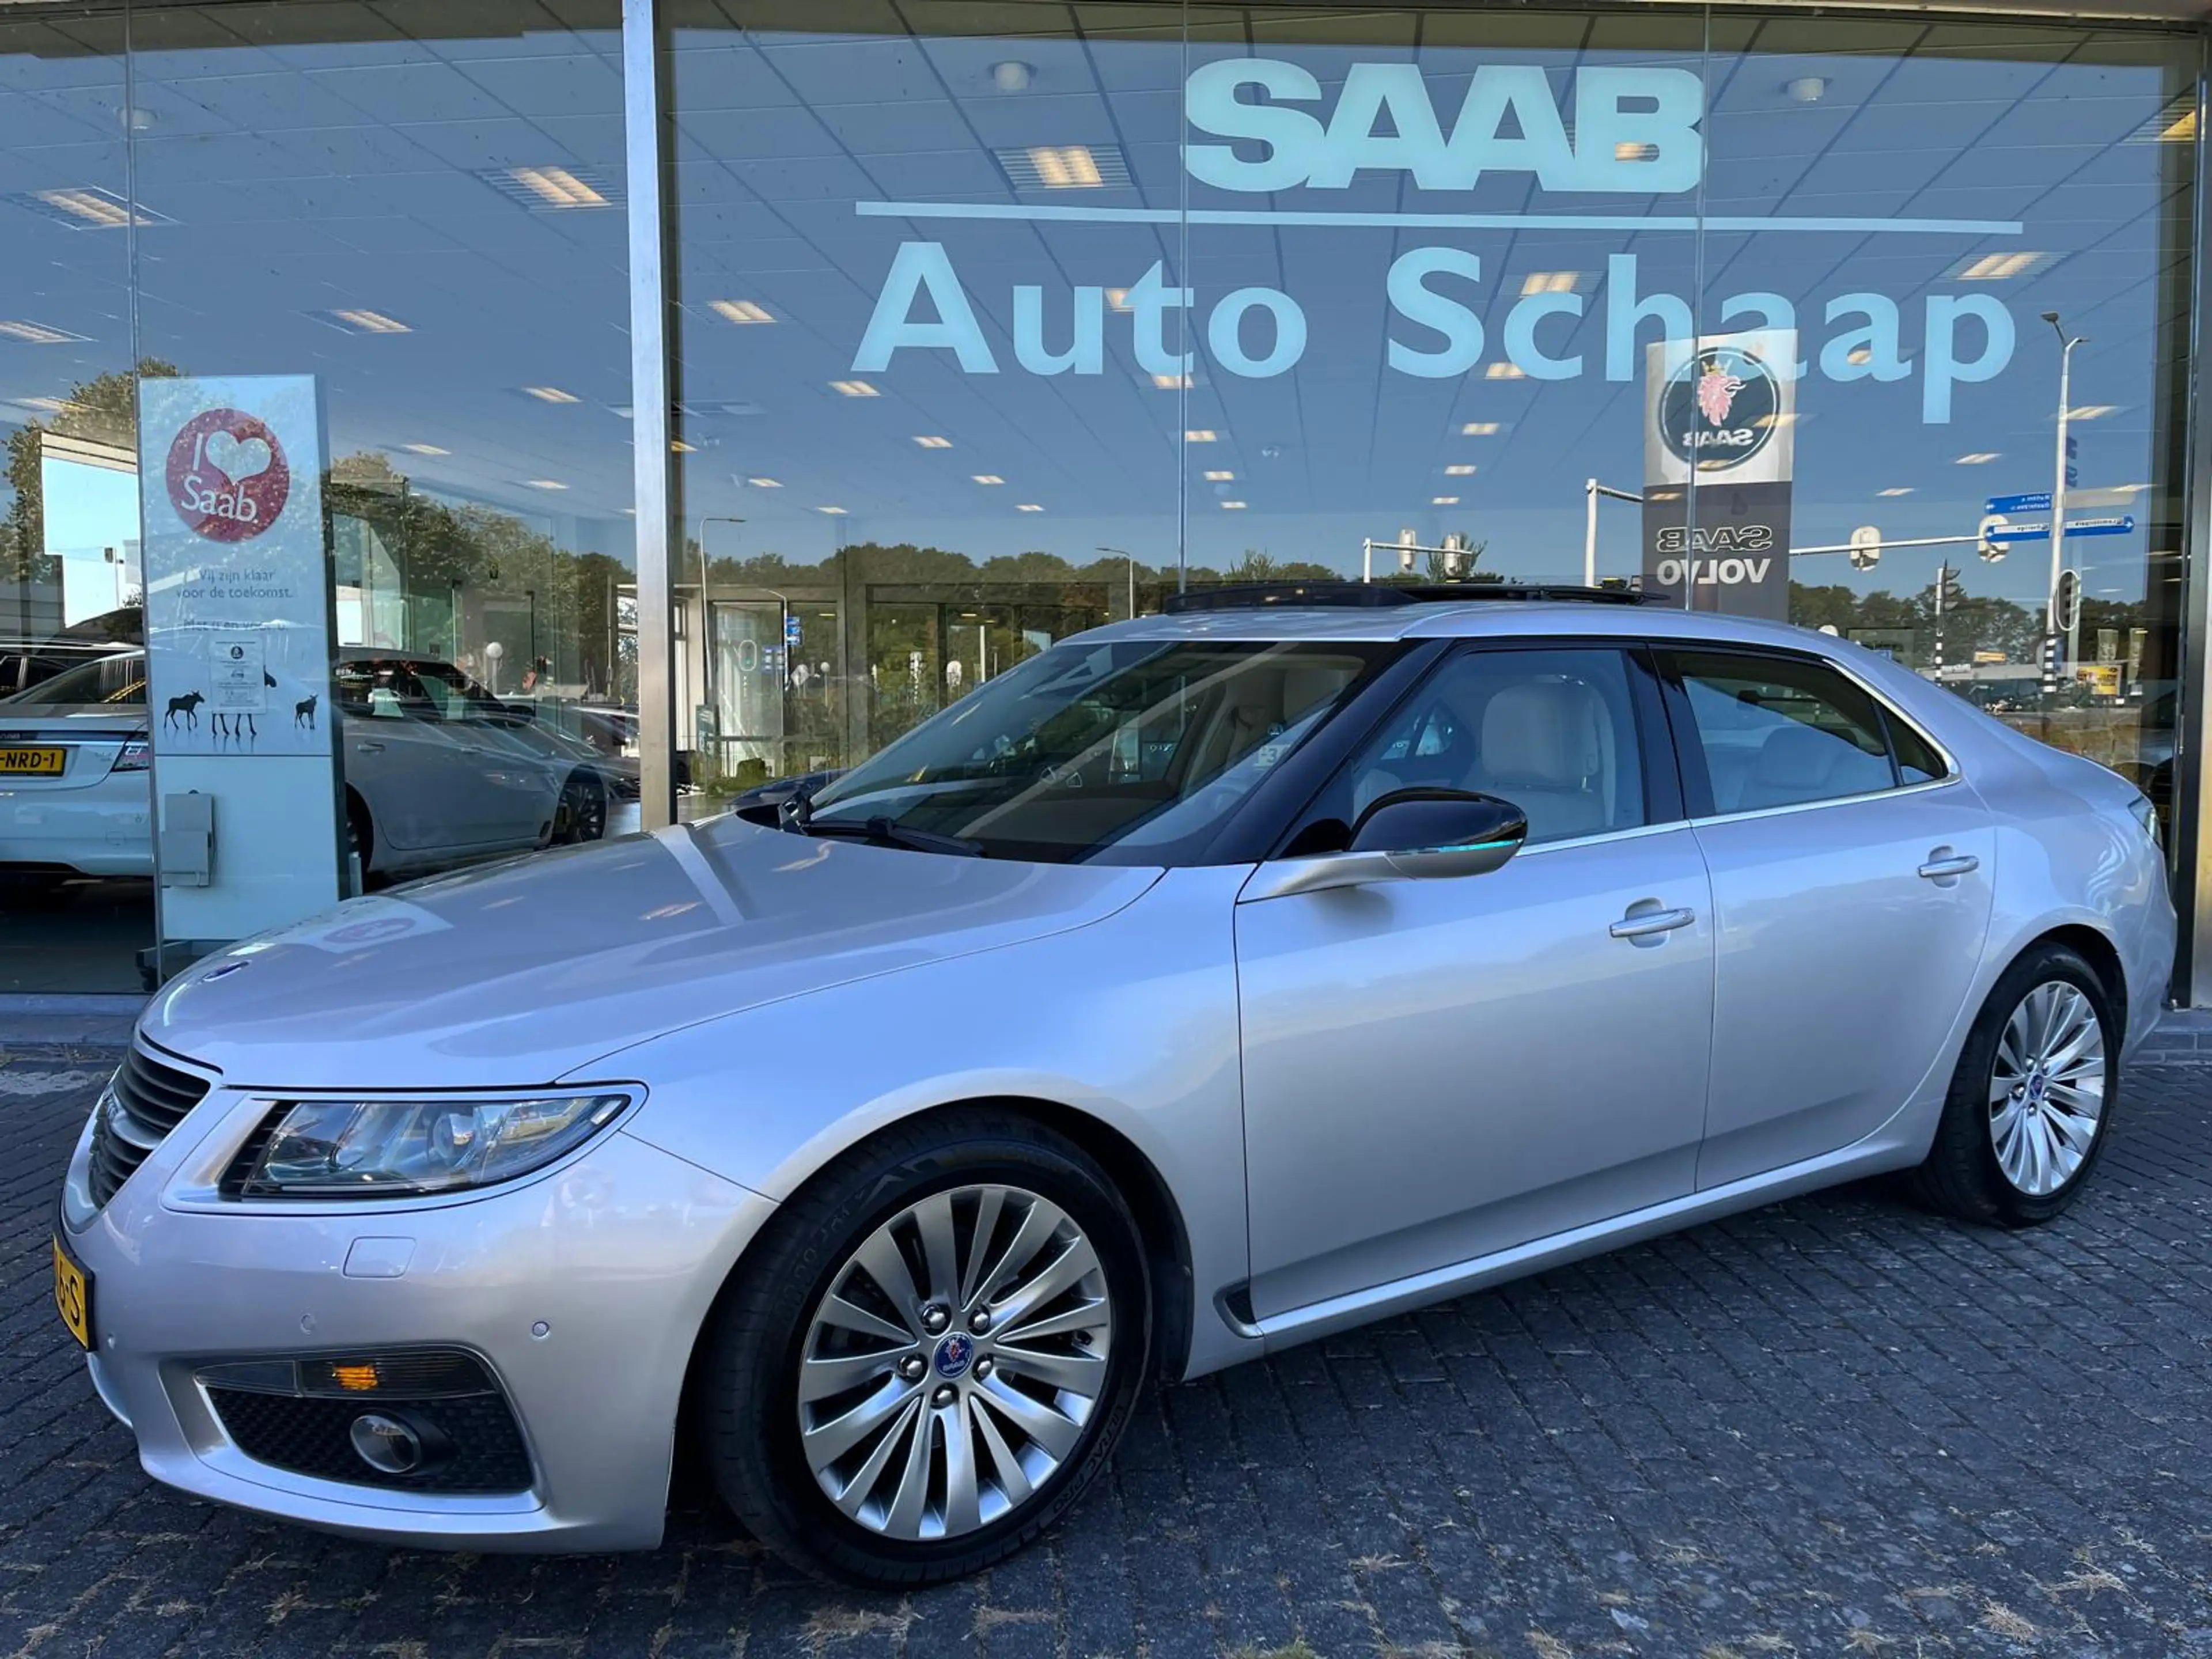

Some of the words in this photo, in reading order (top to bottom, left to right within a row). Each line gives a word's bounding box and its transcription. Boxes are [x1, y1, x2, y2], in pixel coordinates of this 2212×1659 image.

[1183, 59, 1706, 195] SAAB
[850, 241, 1309, 377] Auto
[1387, 247, 2016, 425] Schaap
[192, 433, 204, 471] I
[209, 585, 224, 599] de
